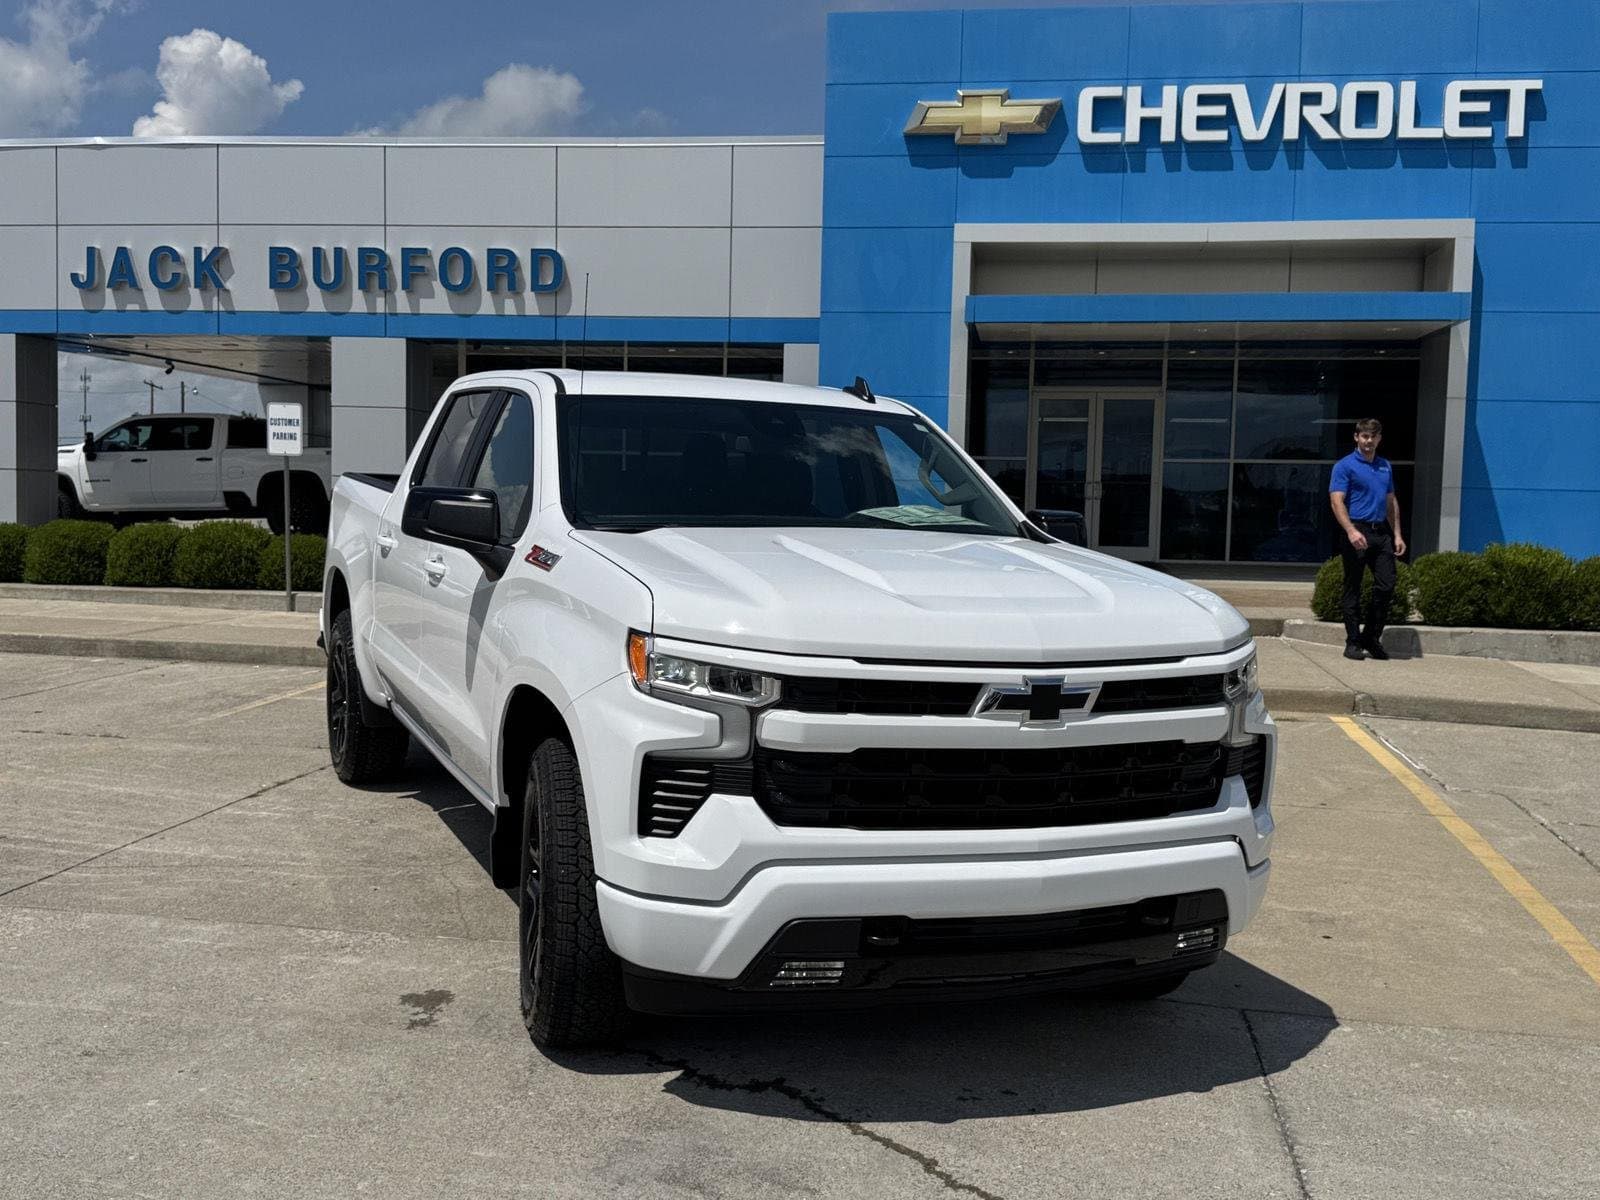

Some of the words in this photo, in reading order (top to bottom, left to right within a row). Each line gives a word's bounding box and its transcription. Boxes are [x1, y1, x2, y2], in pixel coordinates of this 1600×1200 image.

[1076, 78, 1544, 145] CHEVROLET
[70, 245, 227, 291] JACK
[269, 246, 565, 294] BURFORD
[269, 417, 300, 427] CUSTOMER
[272, 431, 298, 441] PARKING
